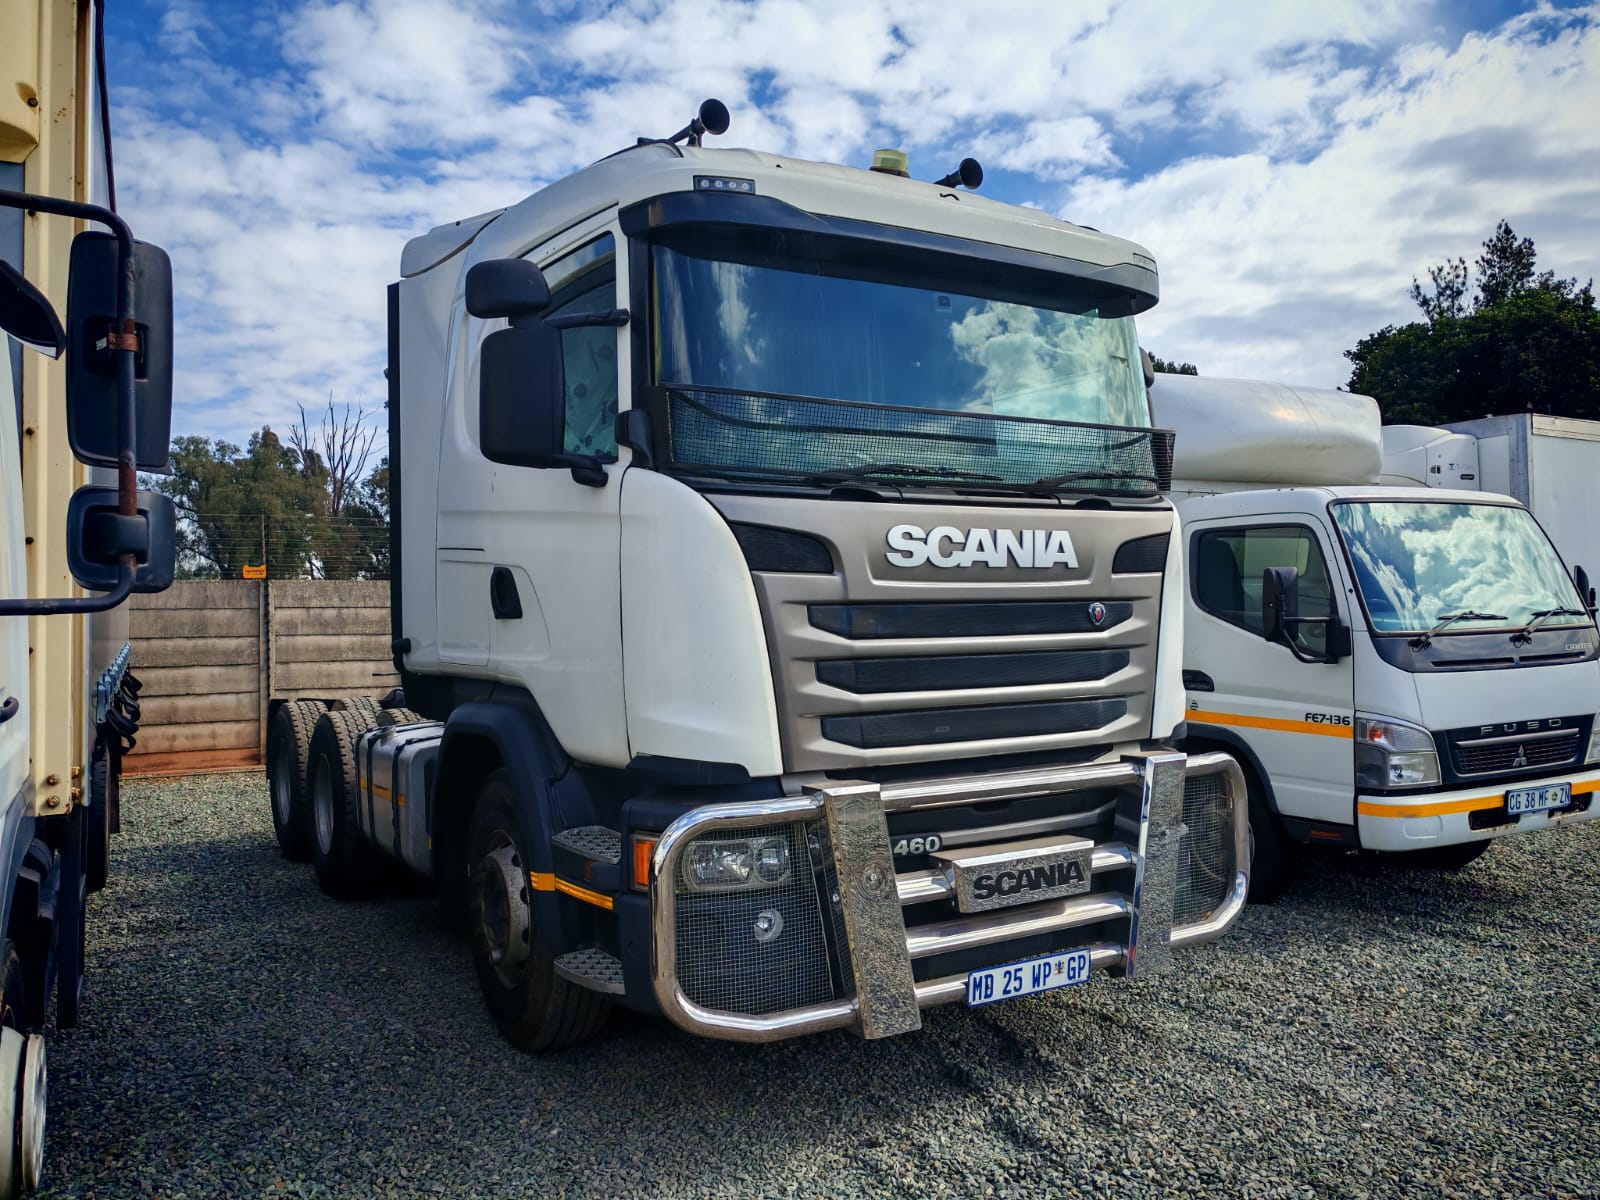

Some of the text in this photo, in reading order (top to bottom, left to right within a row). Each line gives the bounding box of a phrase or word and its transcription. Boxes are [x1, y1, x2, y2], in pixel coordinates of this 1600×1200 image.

[886, 524, 1079, 569] SCANIA
[1305, 712, 1351, 726] FE7-136
[1480, 719, 1562, 735] FUSO
[1509, 793, 1521, 810] CG
[1524, 792, 1536, 809] 38
[1559, 787, 1570, 804] ZN
[893, 836, 940, 856] 460
[973, 860, 1085, 900] SCANIA
[972, 954, 1086, 1002] MD 25 WP GP
